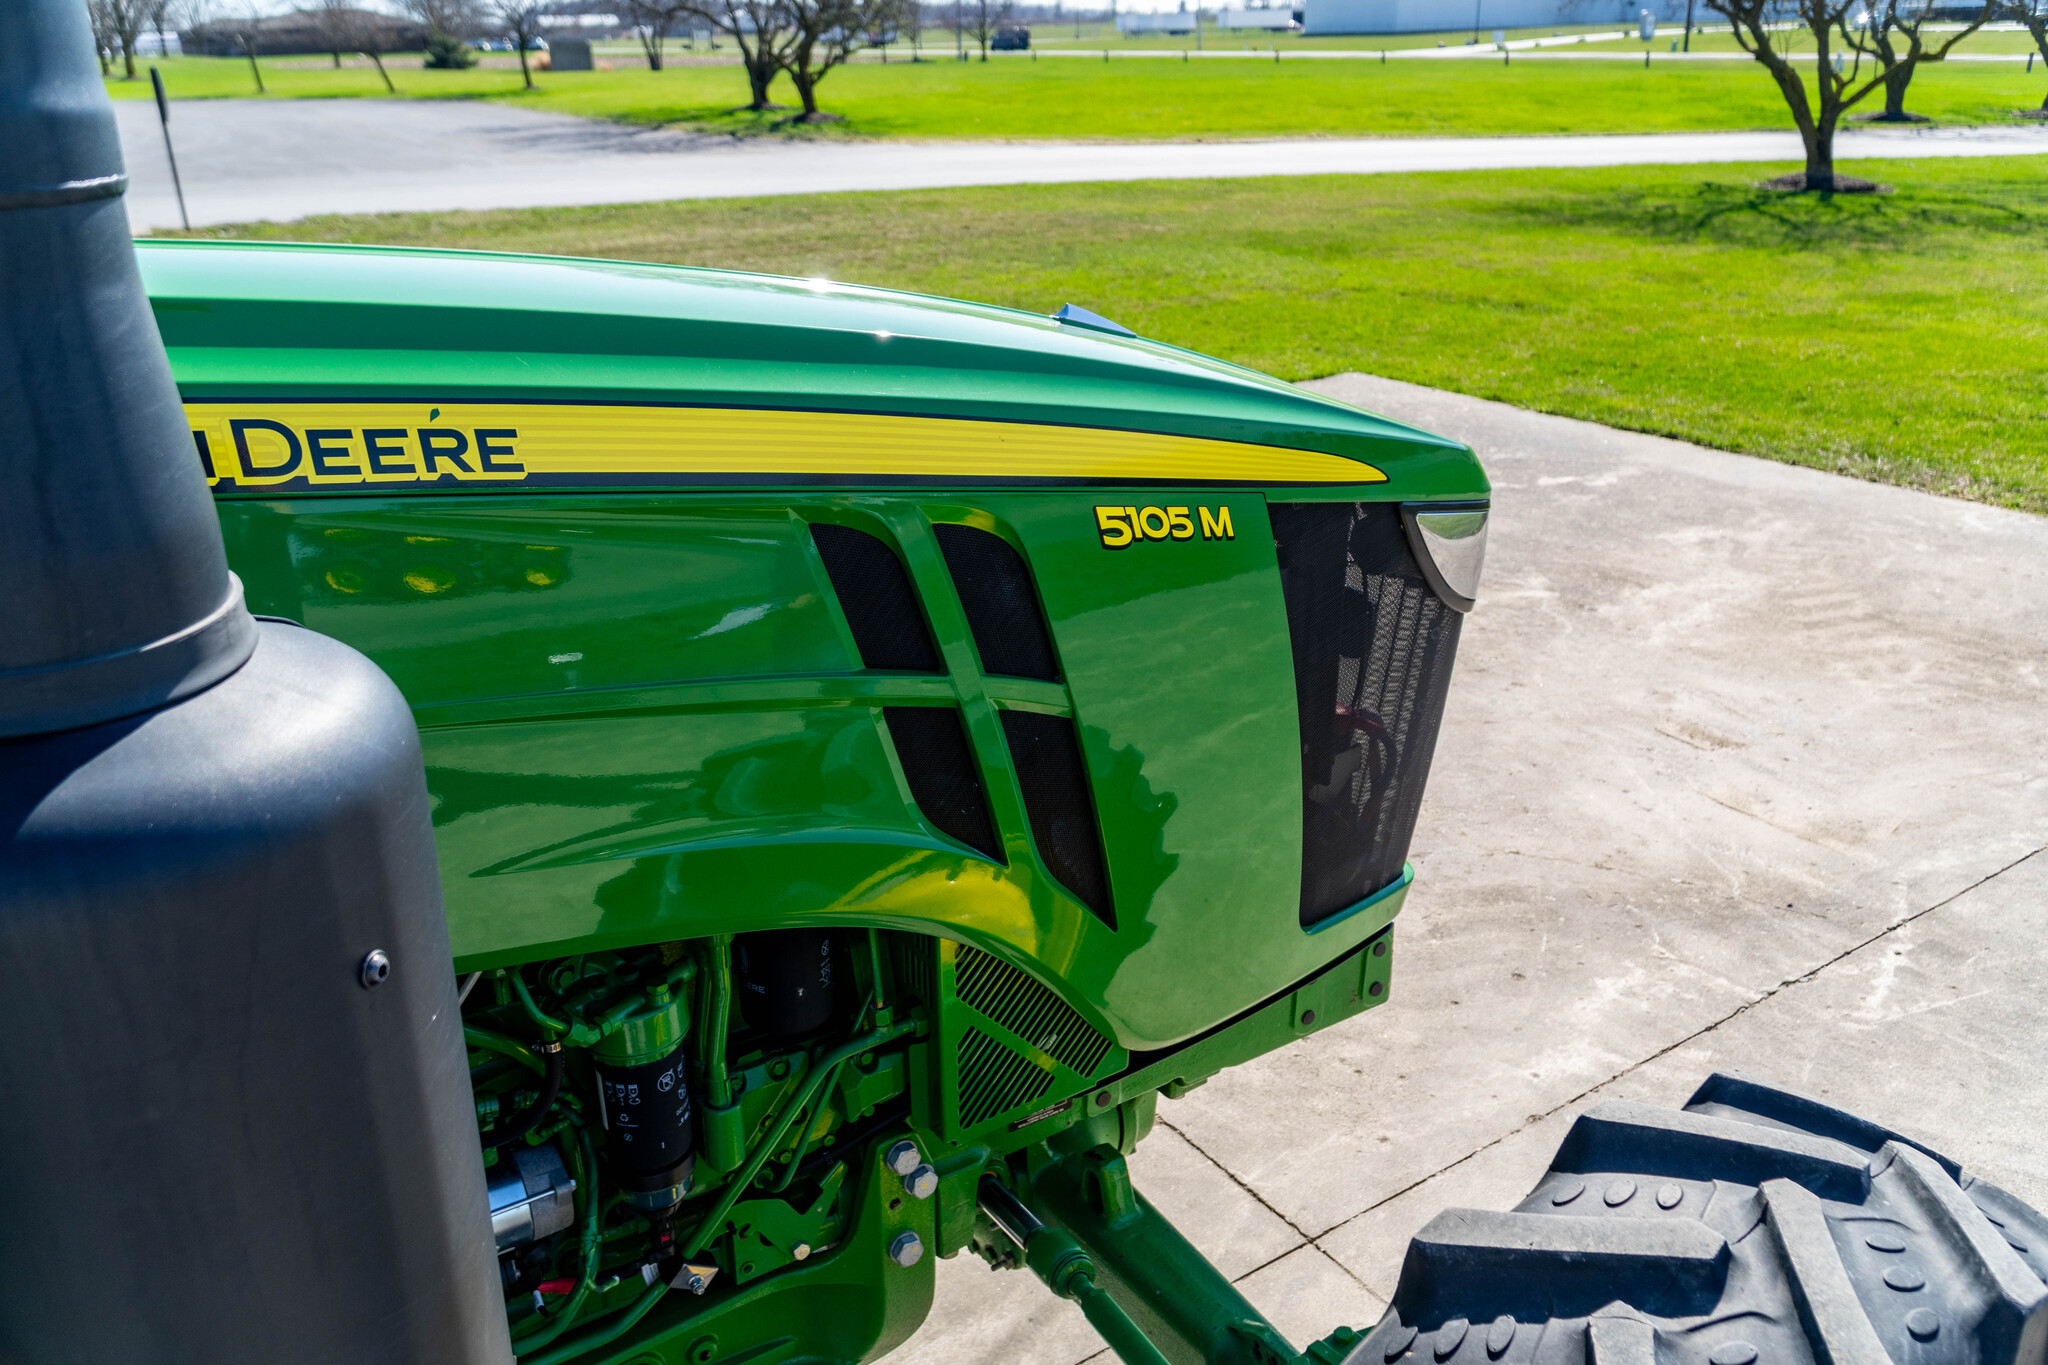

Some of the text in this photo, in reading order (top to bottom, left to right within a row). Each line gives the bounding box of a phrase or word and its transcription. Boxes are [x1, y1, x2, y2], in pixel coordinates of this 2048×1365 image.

[227, 418, 527, 480] DEERE
[1093, 505, 1235, 550] 5105 M
